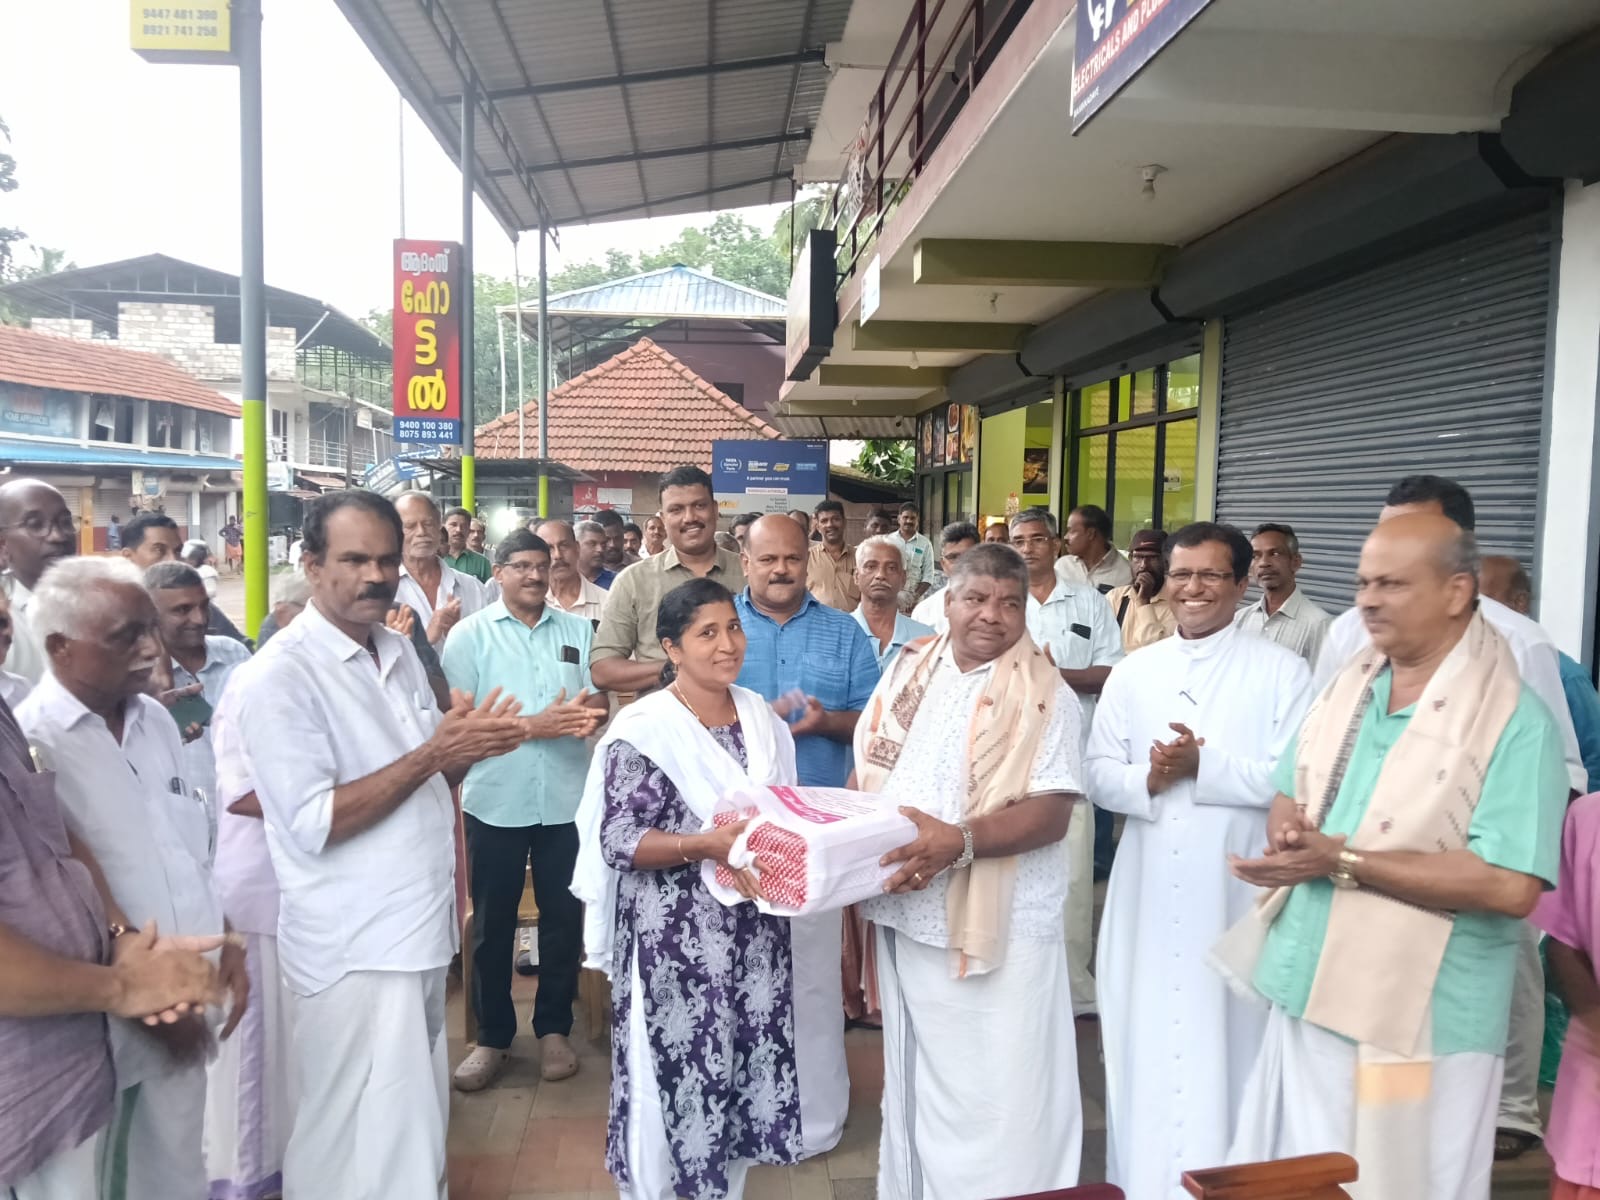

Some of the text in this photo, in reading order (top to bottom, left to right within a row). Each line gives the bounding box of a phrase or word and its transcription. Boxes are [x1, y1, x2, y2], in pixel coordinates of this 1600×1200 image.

[1073, 29, 1121, 98] ELECTRICALS
[1121, 8, 1140, 46] AND
[399, 420, 453, 431] 9400 100 380
[399, 430, 453, 439] 8075 893 441
